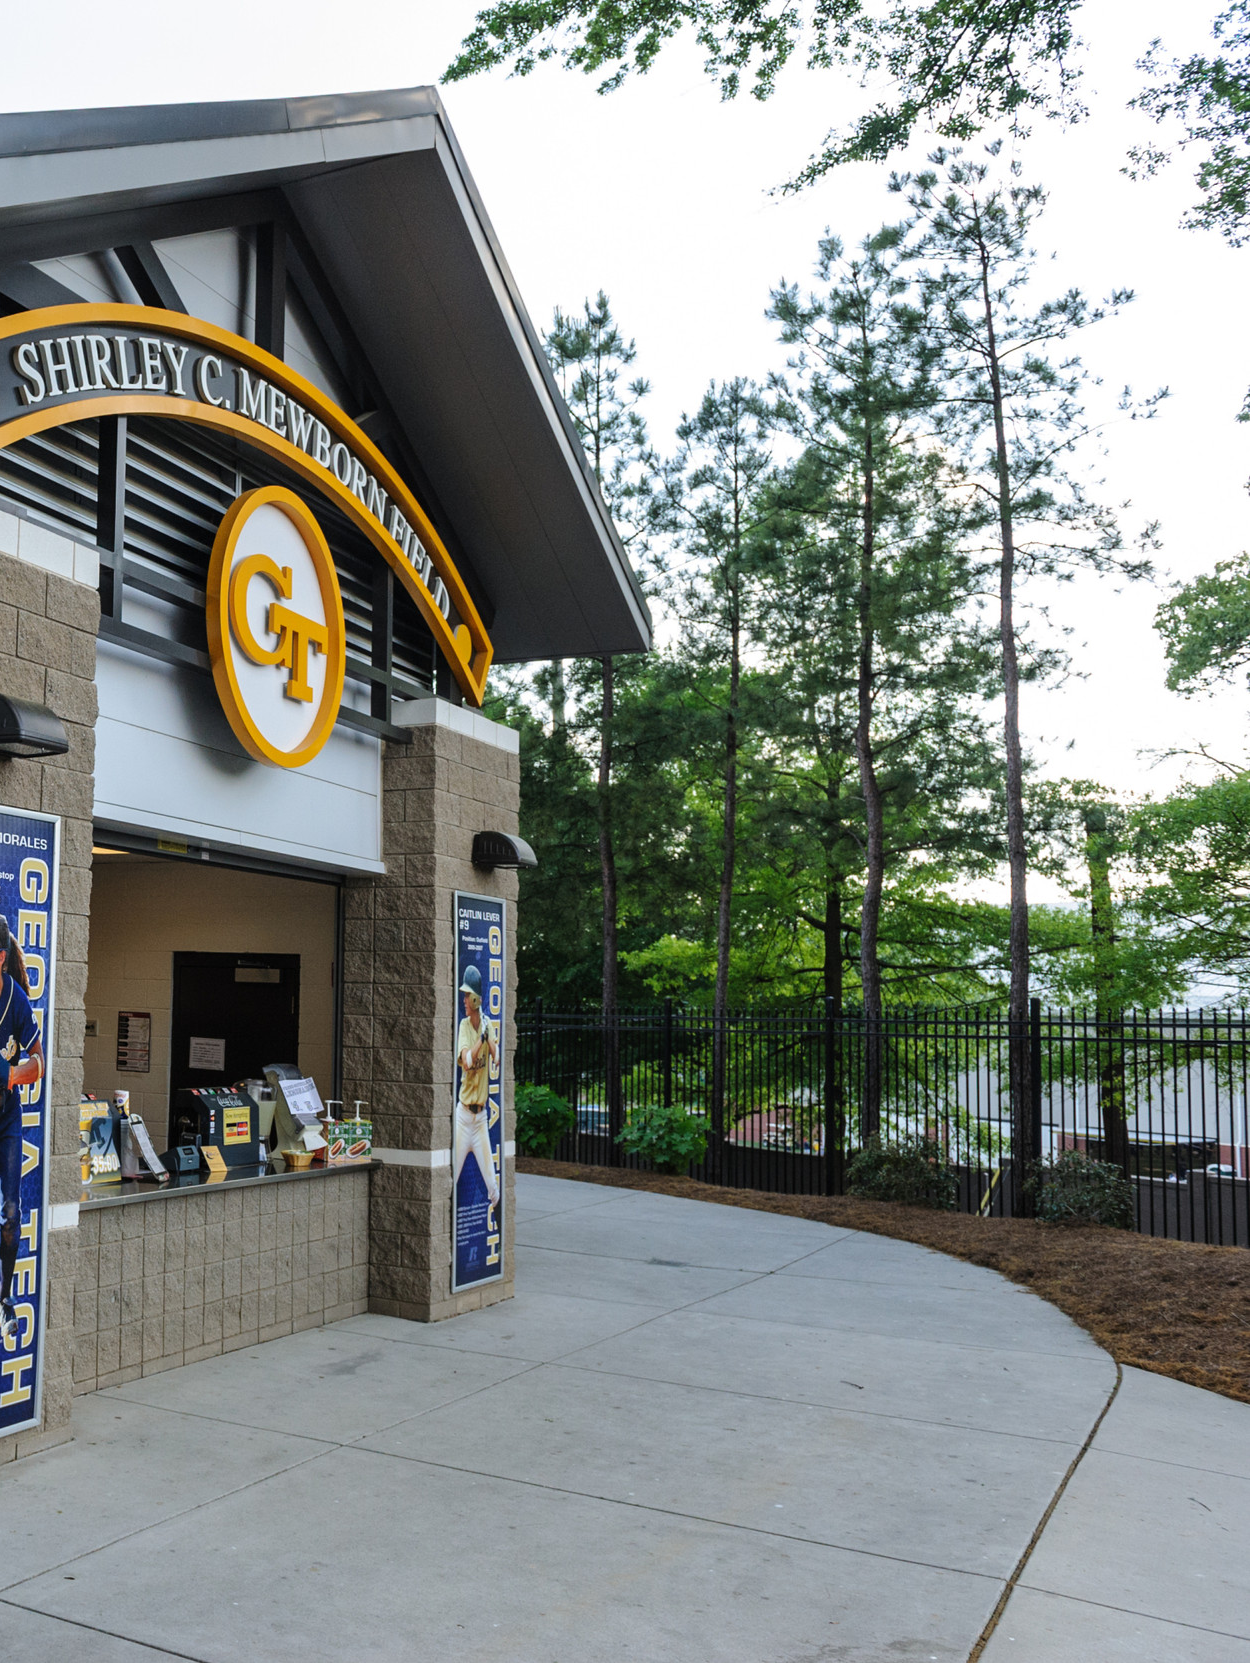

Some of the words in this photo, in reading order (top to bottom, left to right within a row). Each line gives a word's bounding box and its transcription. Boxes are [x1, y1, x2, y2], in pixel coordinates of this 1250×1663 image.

[16, 335, 189, 404] SHIRLEY
[199, 355, 231, 409] C.
[239, 367, 388, 524] MEWBORN
[390, 505, 450, 620] FIELD
[229, 554, 329, 703] GT
[459, 908, 482, 920] CAITLIN
[482, 911, 500, 922] LEVER
[459, 920, 469, 931] #9
